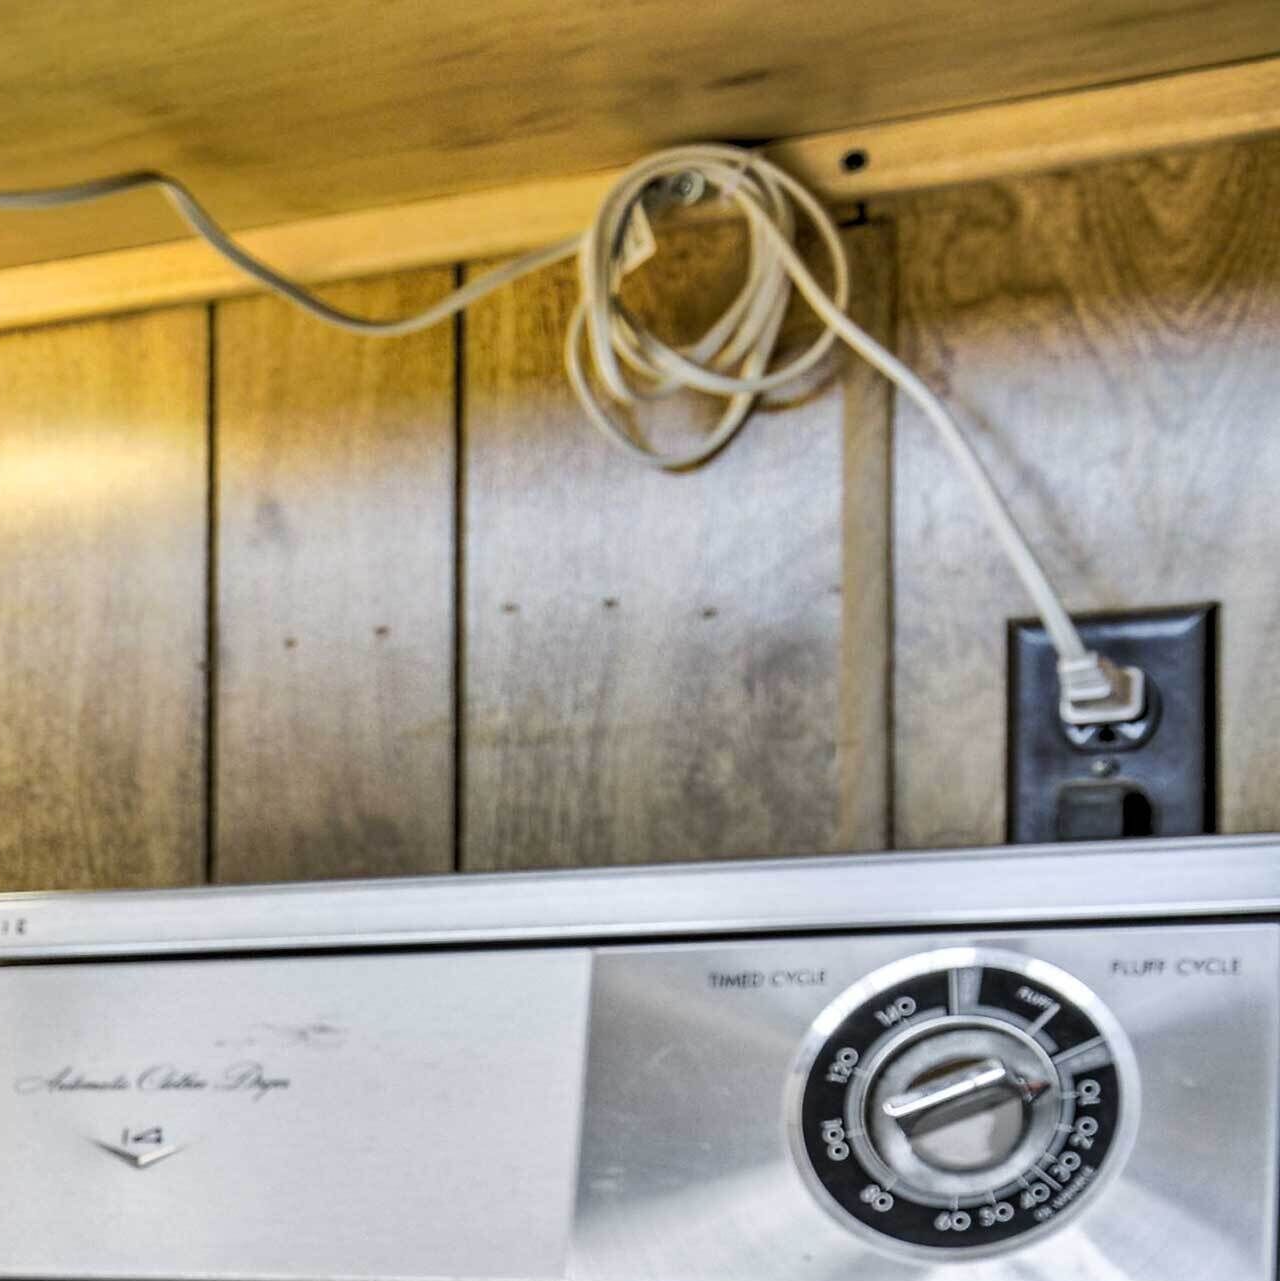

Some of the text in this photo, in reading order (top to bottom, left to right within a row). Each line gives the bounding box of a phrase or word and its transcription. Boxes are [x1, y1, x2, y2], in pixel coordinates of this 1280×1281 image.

[707, 967, 827, 990] TIMED CYCLE
[1110, 957, 1242, 977] FLUFF CYCLE
[826, 1047, 859, 1083] 120
[1076, 1079, 1101, 1105] 10
[820, 1118, 851, 1161] 100
[1068, 1116, 1100, 1149] 20
[1048, 1150, 1081, 1183] 30
[860, 1184, 894, 1212] 80
[1020, 1182, 1050, 1209] 40
